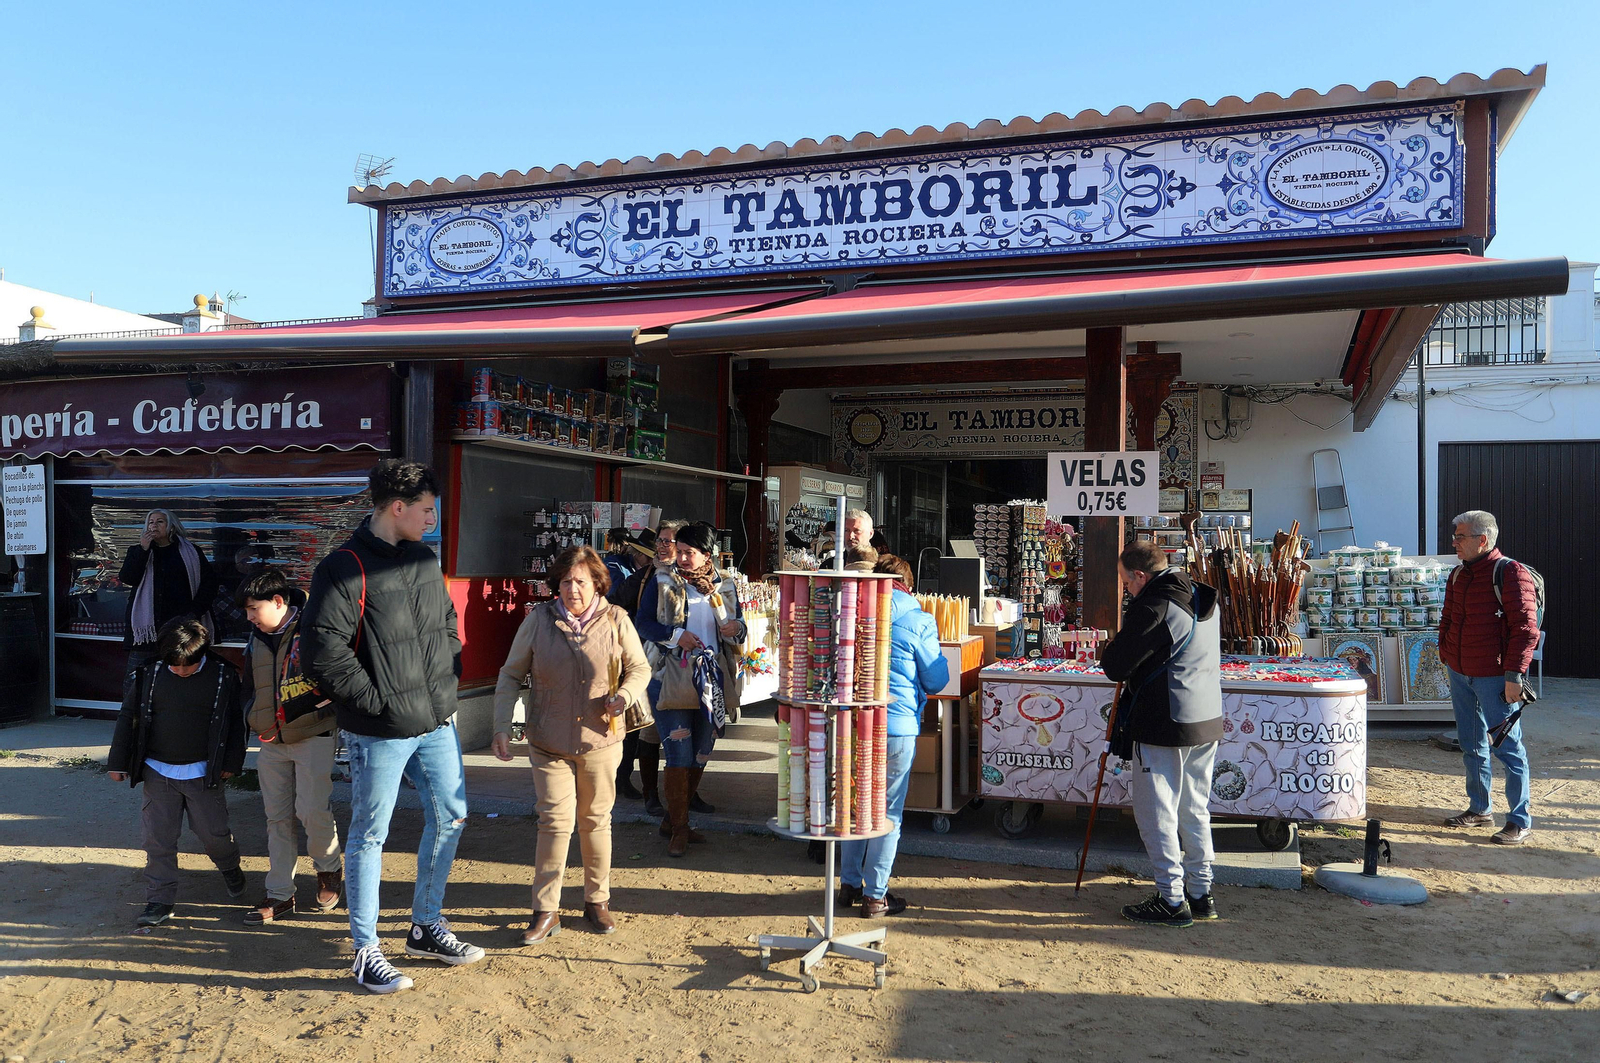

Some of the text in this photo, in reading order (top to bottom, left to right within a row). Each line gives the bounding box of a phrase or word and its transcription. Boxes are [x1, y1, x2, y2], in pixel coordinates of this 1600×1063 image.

[1270, 145, 1323, 180] LA PRIMITIVA
[1331, 144, 1383, 172] LA ORIGINAL
[1282, 169, 1371, 184] EL TAMBORIL
[1325, 180, 1360, 188] ROCIERA
[622, 164, 1098, 241] EL TAMBORIL
[1274, 182, 1378, 209] ESTABLECIDAS DESDE 1890
[433, 220, 476, 243] TRAJES CORTOS
[482, 223, 500, 239] BOTOS
[729, 222, 967, 253] TIENDA ROCIERA
[451, 240, 493, 250] TAMBORIL
[436, 253, 496, 270] GORRAS SOMBREROS
[1, 403, 96, 447] pería
[132, 392, 324, 434] Cafetería
[900, 407, 1086, 431] EL TAMBOR
[948, 434, 1061, 444] TIENDA ROCIERA
[4, 471, 28, 480] Bocadillos
[1060, 459, 1146, 487] VELAS
[5, 484, 18, 493] Lomo
[22, 483, 27, 492] la
[27, 482, 45, 493] plancha
[802, 478, 821, 490] PULSERAS
[825, 482, 843, 493] ROSARIOS
[5, 494, 43, 506] Pechuga de pollo
[1077, 491, 1127, 515] 0,75€
[6, 508, 27, 518] De queso
[6, 520, 28, 529] De jamón
[14, 544, 37, 552] calamares
[1261, 720, 1363, 744] REGALOS
[996, 752, 1073, 770] PULSERAS
[1306, 749, 1335, 766] del
[1280, 771, 1354, 794] ROCIO
